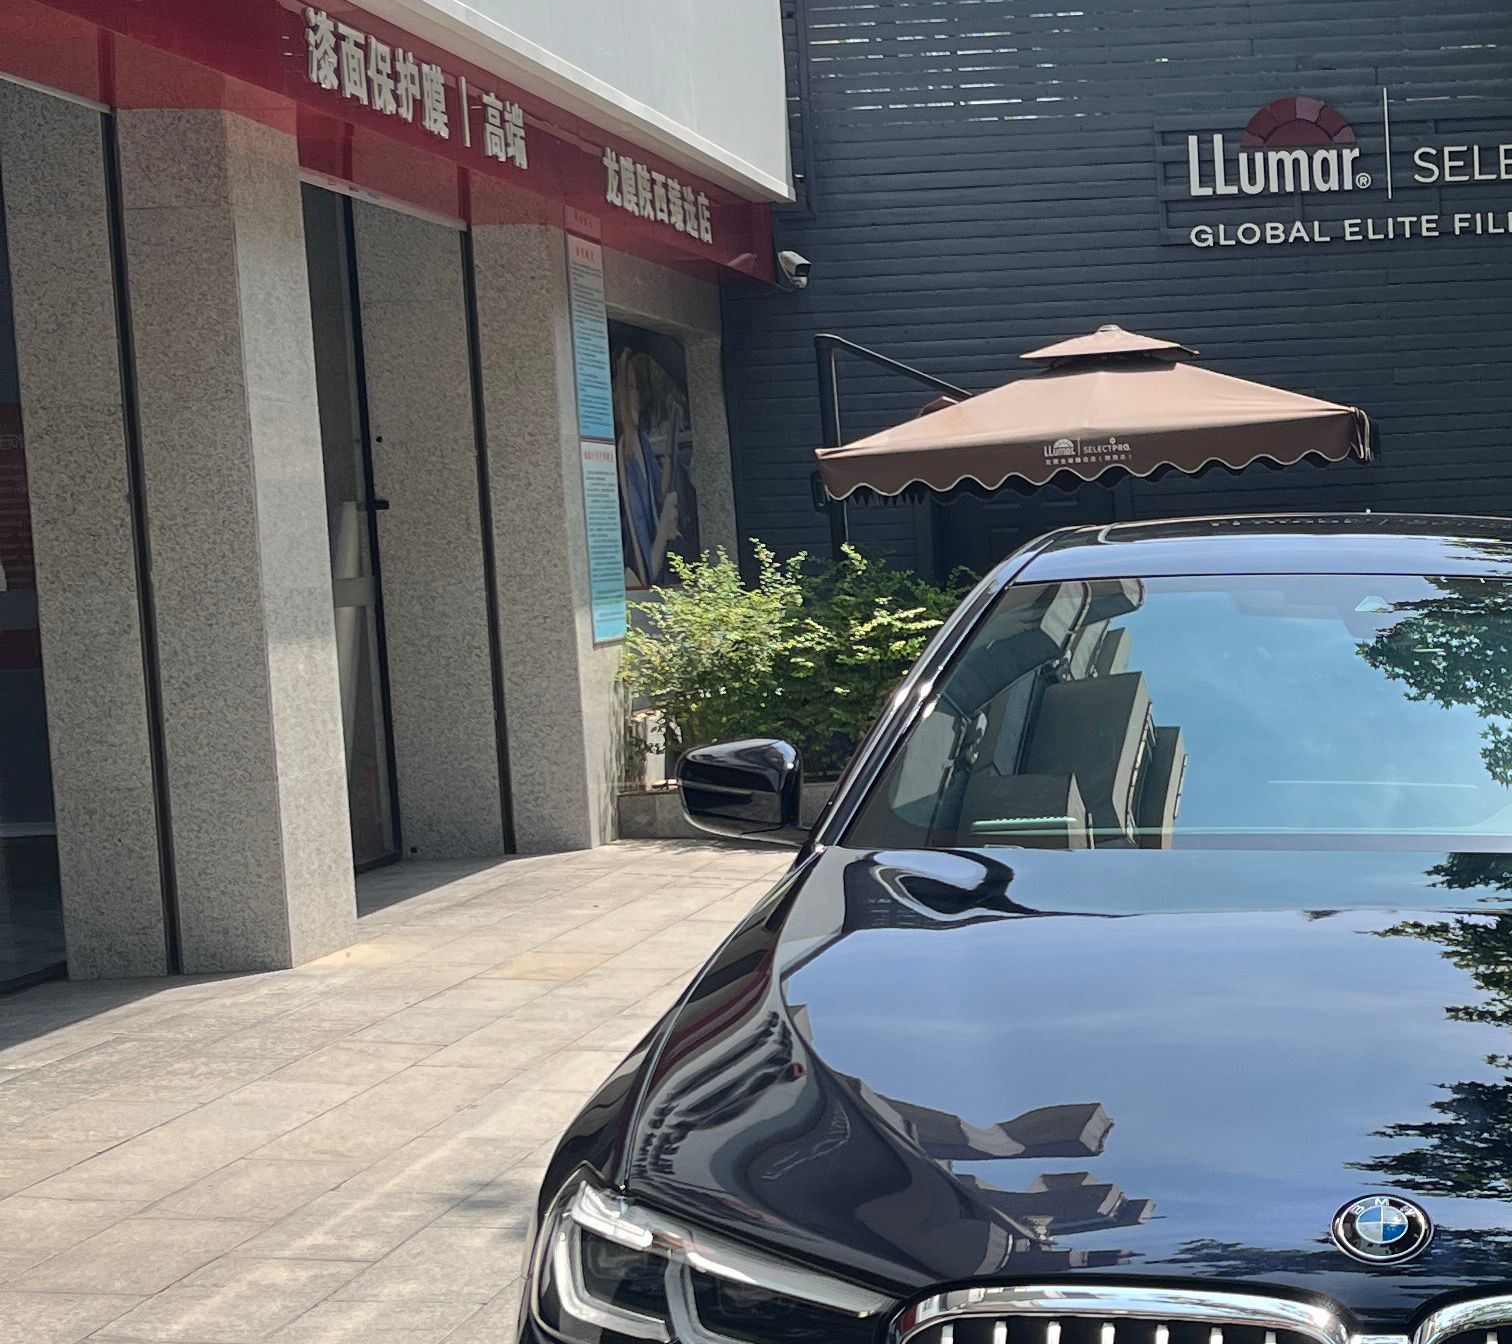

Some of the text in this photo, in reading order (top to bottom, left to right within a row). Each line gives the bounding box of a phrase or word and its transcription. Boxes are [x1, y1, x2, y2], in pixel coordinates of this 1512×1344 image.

[305, 7, 528, 170] 漆面保护膜 高端
[1190, 220, 1330, 247] GLOBAL
[1344, 214, 1439, 239] ELITE
[1348, 1197, 1416, 1217] BMW
